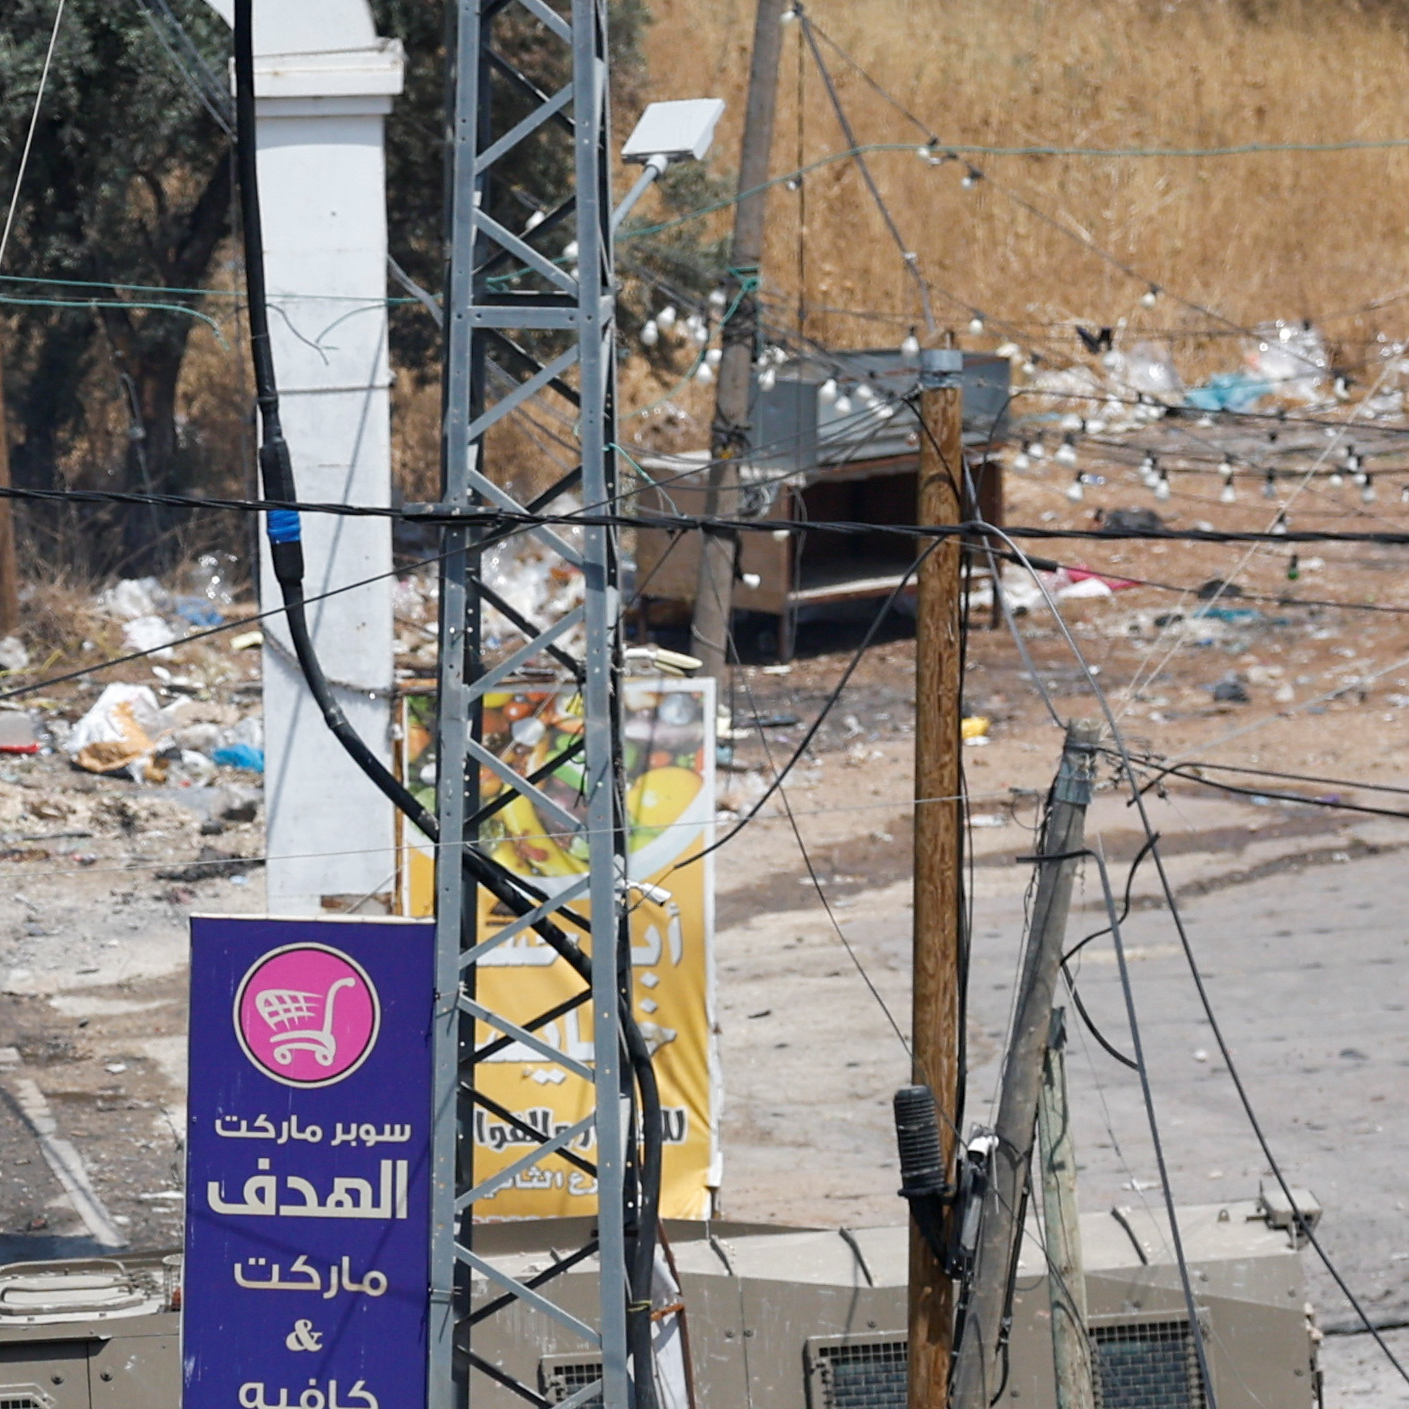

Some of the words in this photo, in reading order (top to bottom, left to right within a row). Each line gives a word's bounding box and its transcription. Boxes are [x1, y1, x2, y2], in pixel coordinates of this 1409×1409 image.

[214, 1113, 324, 1145] ماركت
[332, 1122, 412, 1147] سوبر
[206, 1156, 409, 1219] الهدف
[233, 1254, 389, 1300] ماركت
[285, 1318, 324, 1352] &
